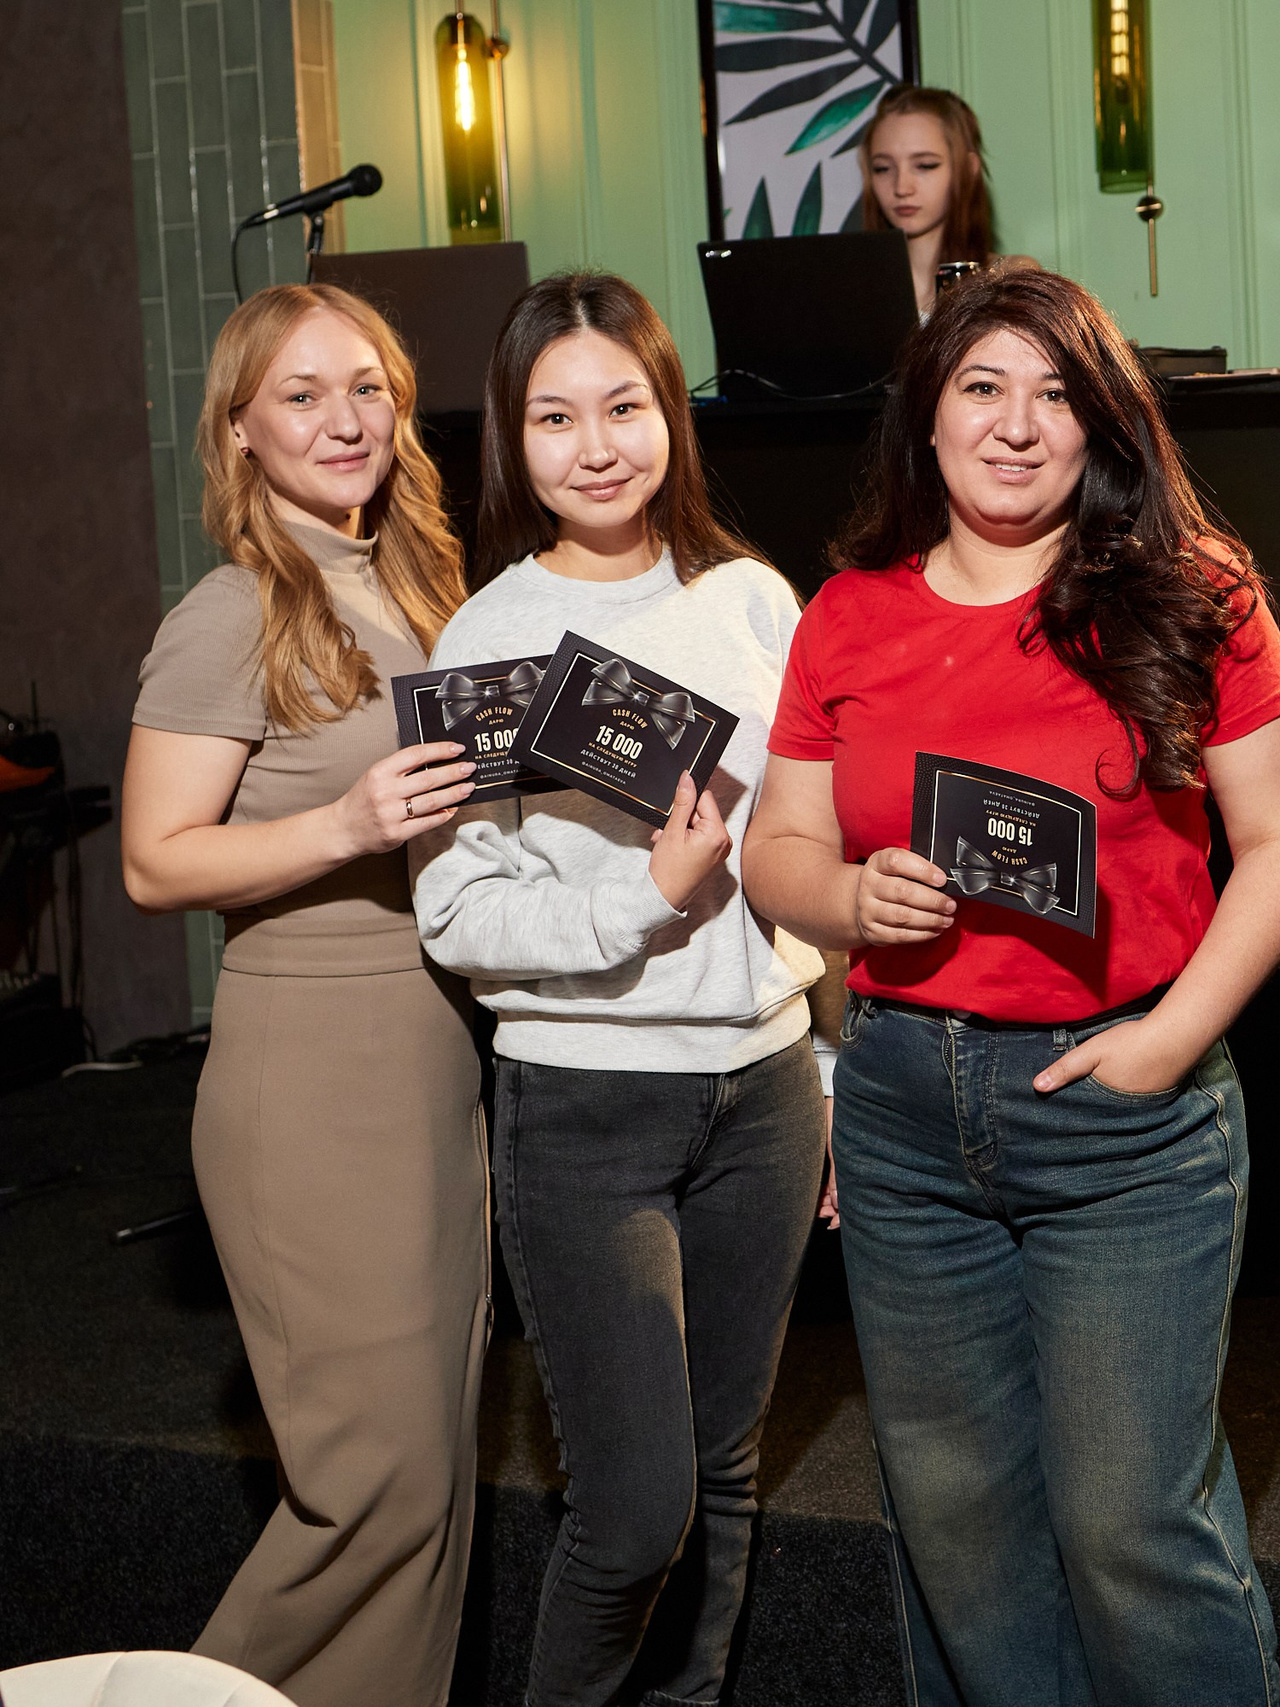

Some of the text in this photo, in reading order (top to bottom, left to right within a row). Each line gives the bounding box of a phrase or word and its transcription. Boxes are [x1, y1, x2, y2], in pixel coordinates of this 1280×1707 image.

[475, 706, 513, 721] CASH FLOW
[612, 708, 648, 729] CASH FLOW
[474, 732, 491, 752] 15
[595, 725, 643, 760] 15 000
[477, 760, 505, 769] ЕЙСТВУТ
[618, 767, 637, 779] ДНЕЙ
[983, 799, 1000, 807] ДНЕЙ
[988, 817, 1033, 847] 15 000
[991, 850, 1028, 865] CASH FLOW
